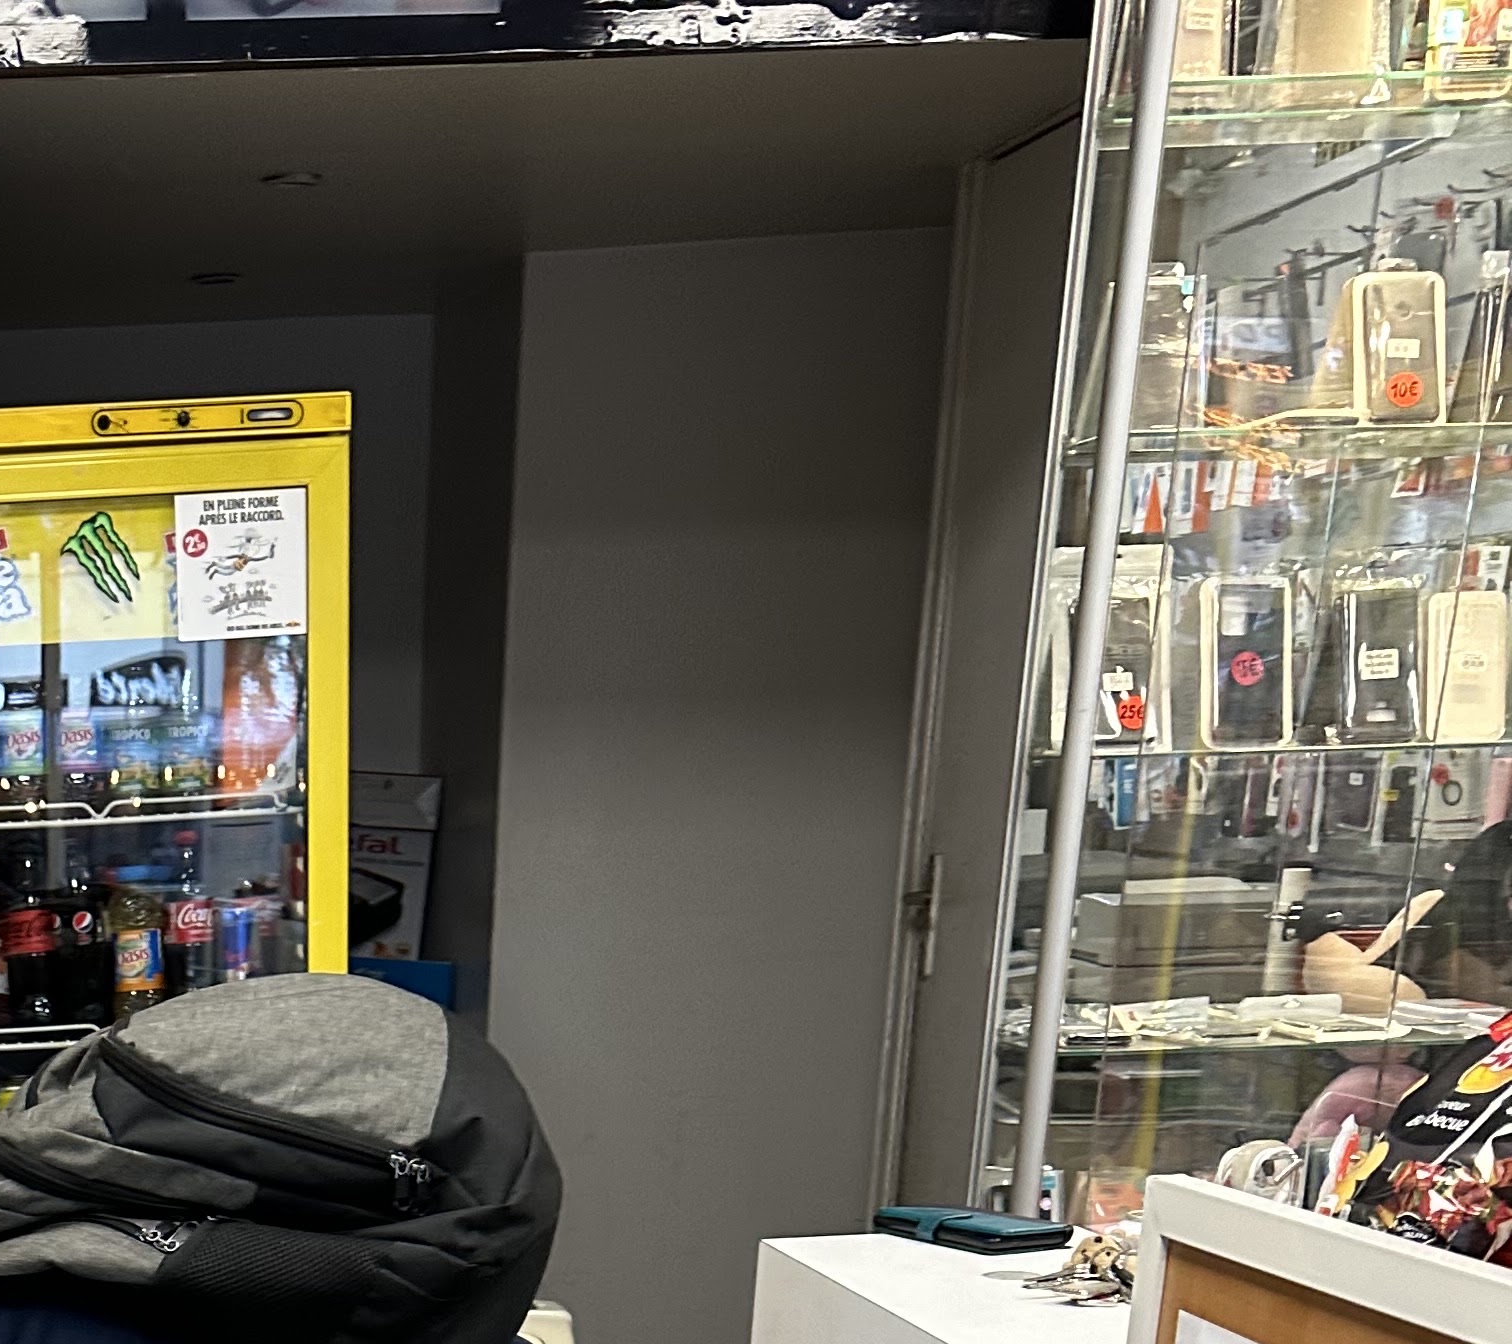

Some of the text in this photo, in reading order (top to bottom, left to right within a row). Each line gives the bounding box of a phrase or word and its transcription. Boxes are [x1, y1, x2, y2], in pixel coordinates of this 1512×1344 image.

[1390, 380, 1419, 399] 10€
[203, 496, 279, 512] EN PLEINE FORME
[229, 512, 238, 525] LE
[1120, 705, 1144, 719] 25€
[7, 729, 41, 747] Oasis
[60, 729, 93, 747] Oasis
